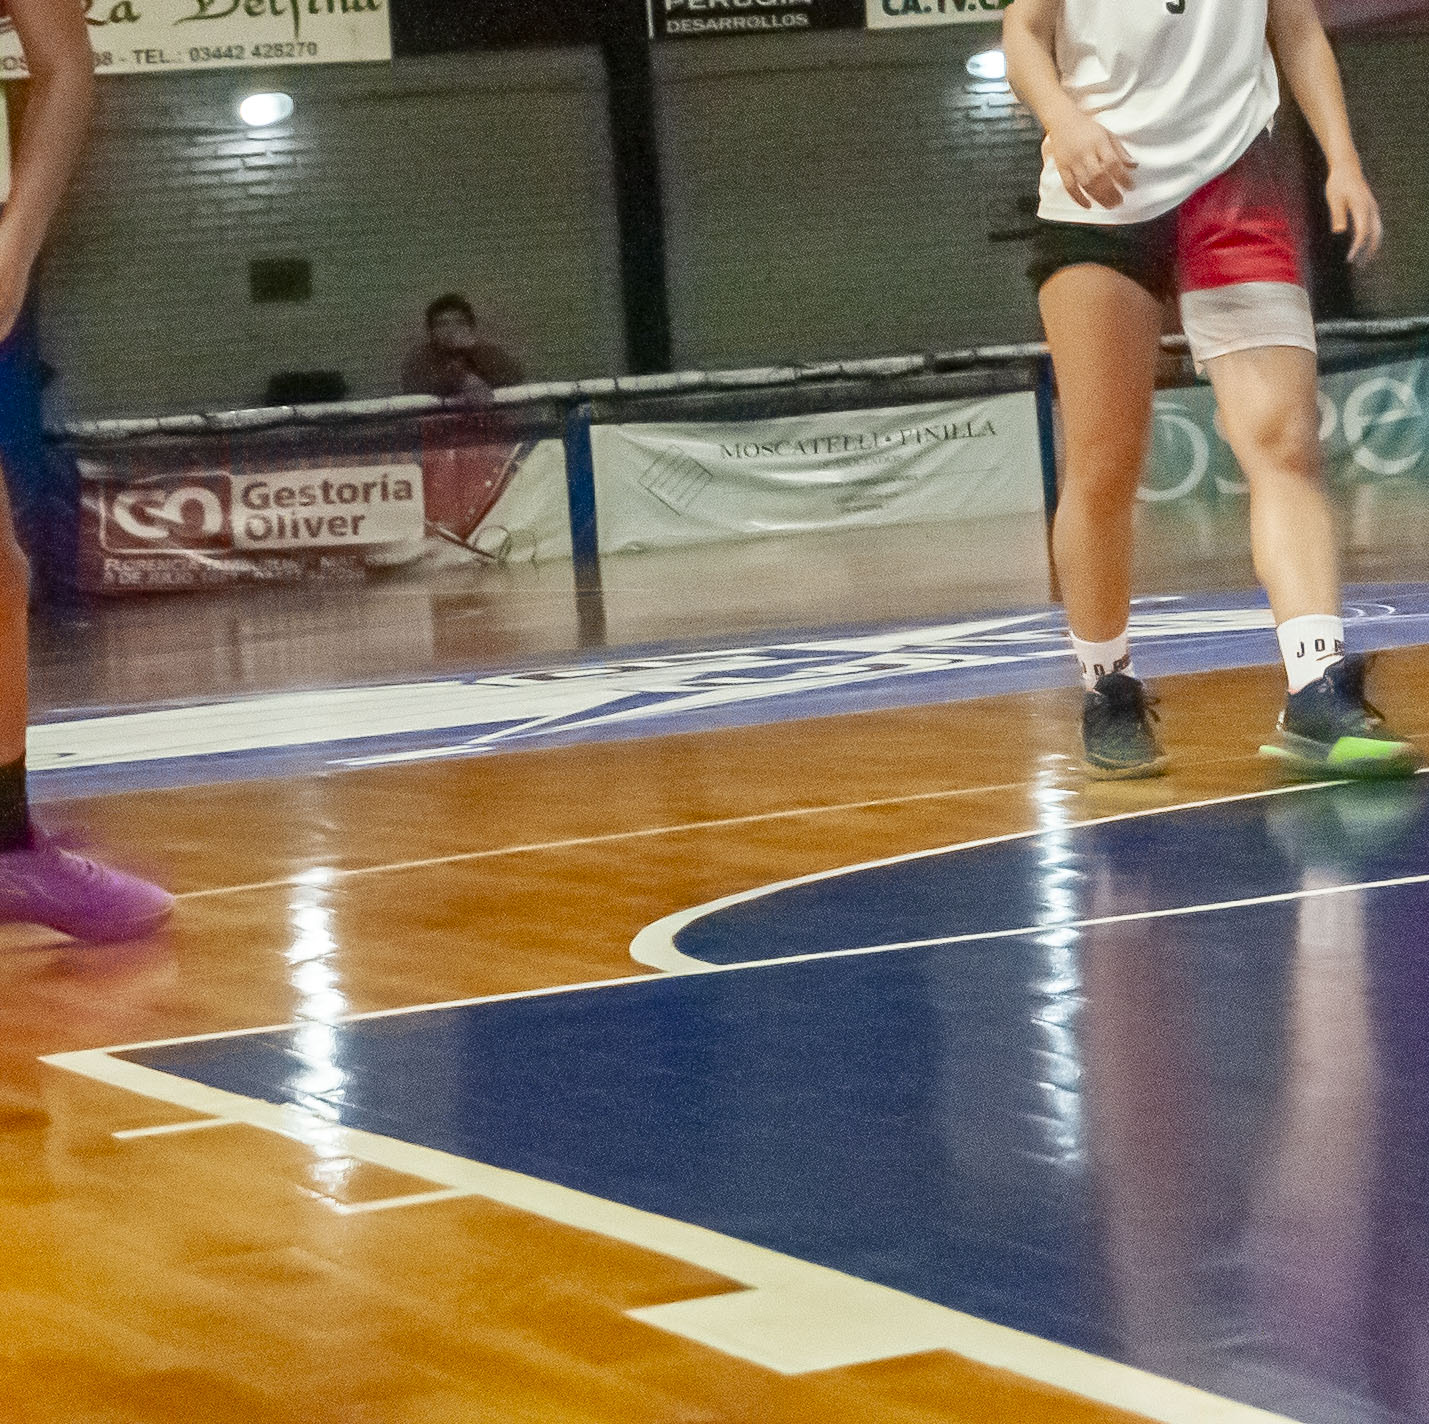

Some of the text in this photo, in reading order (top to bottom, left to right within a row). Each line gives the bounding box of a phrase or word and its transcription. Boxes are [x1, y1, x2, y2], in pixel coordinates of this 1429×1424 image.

[666, 13, 810, 34] DESARROLLOS
[189, 46, 245, 63] 03442
[719, 421, 996, 460] MOSCATELLI PINILLA
[244, 511, 366, 541] Oliver
